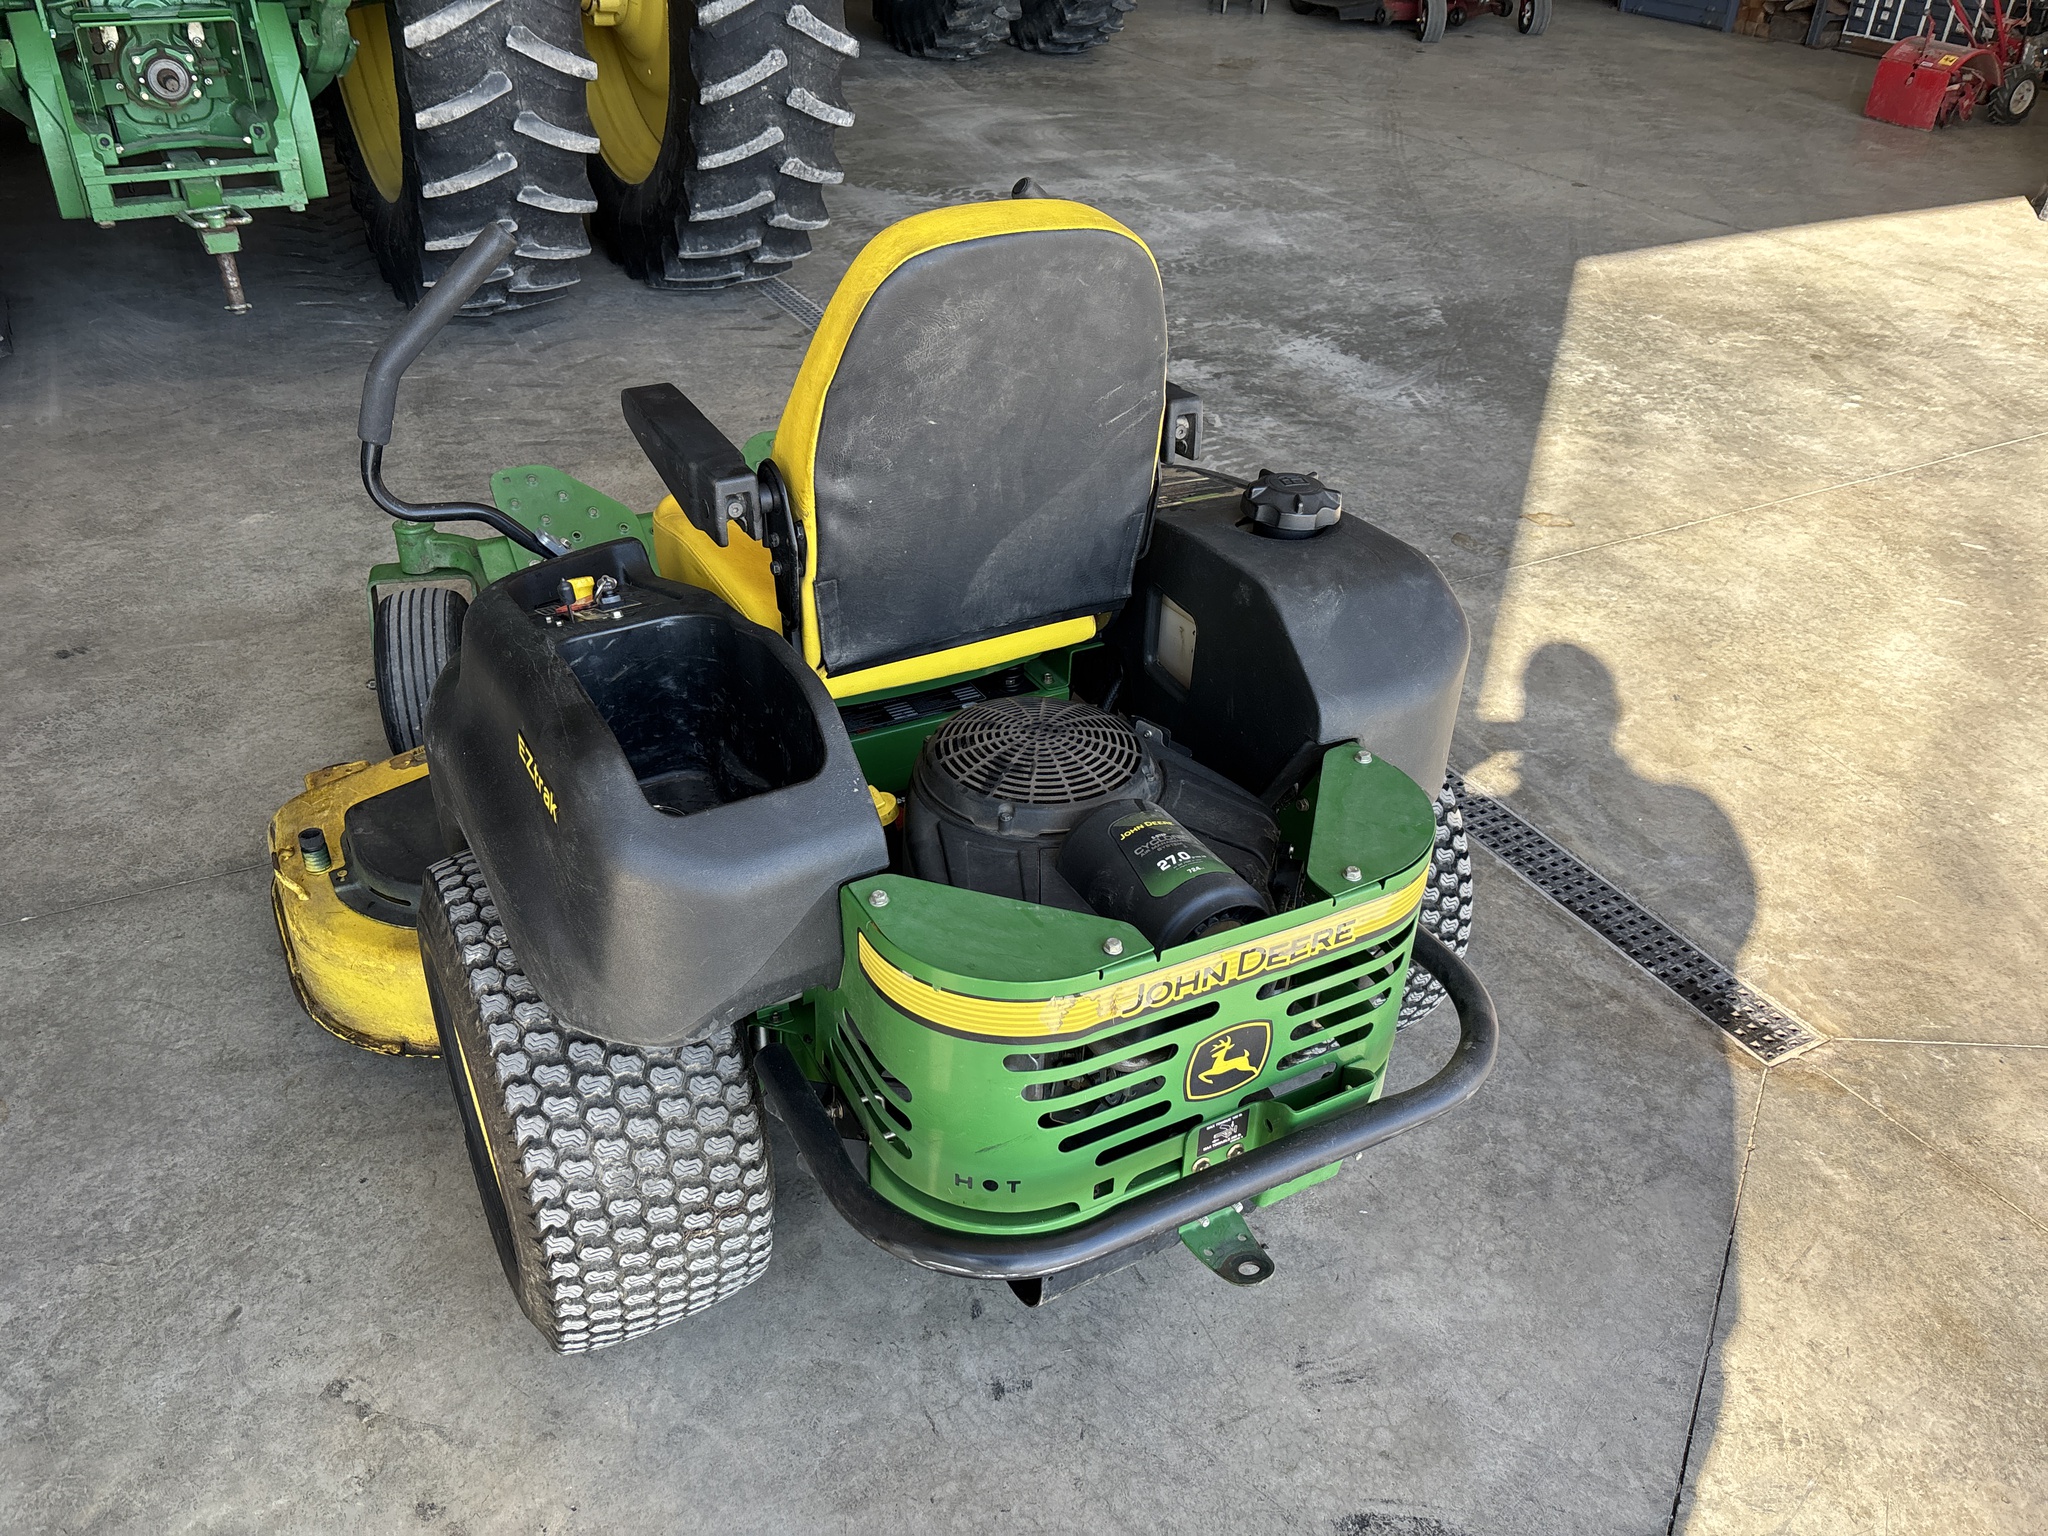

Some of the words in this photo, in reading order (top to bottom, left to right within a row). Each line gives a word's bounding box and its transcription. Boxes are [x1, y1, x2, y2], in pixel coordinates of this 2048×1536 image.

[517, 732, 558, 824] EZtrak
[1120, 823, 1145, 841] JOHN
[1156, 851, 1191, 871] 27.0
[1121, 960, 1229, 1015] JOHN
[1236, 919, 1357, 979] DEERE
[954, 1173, 1022, 1193] HOT
